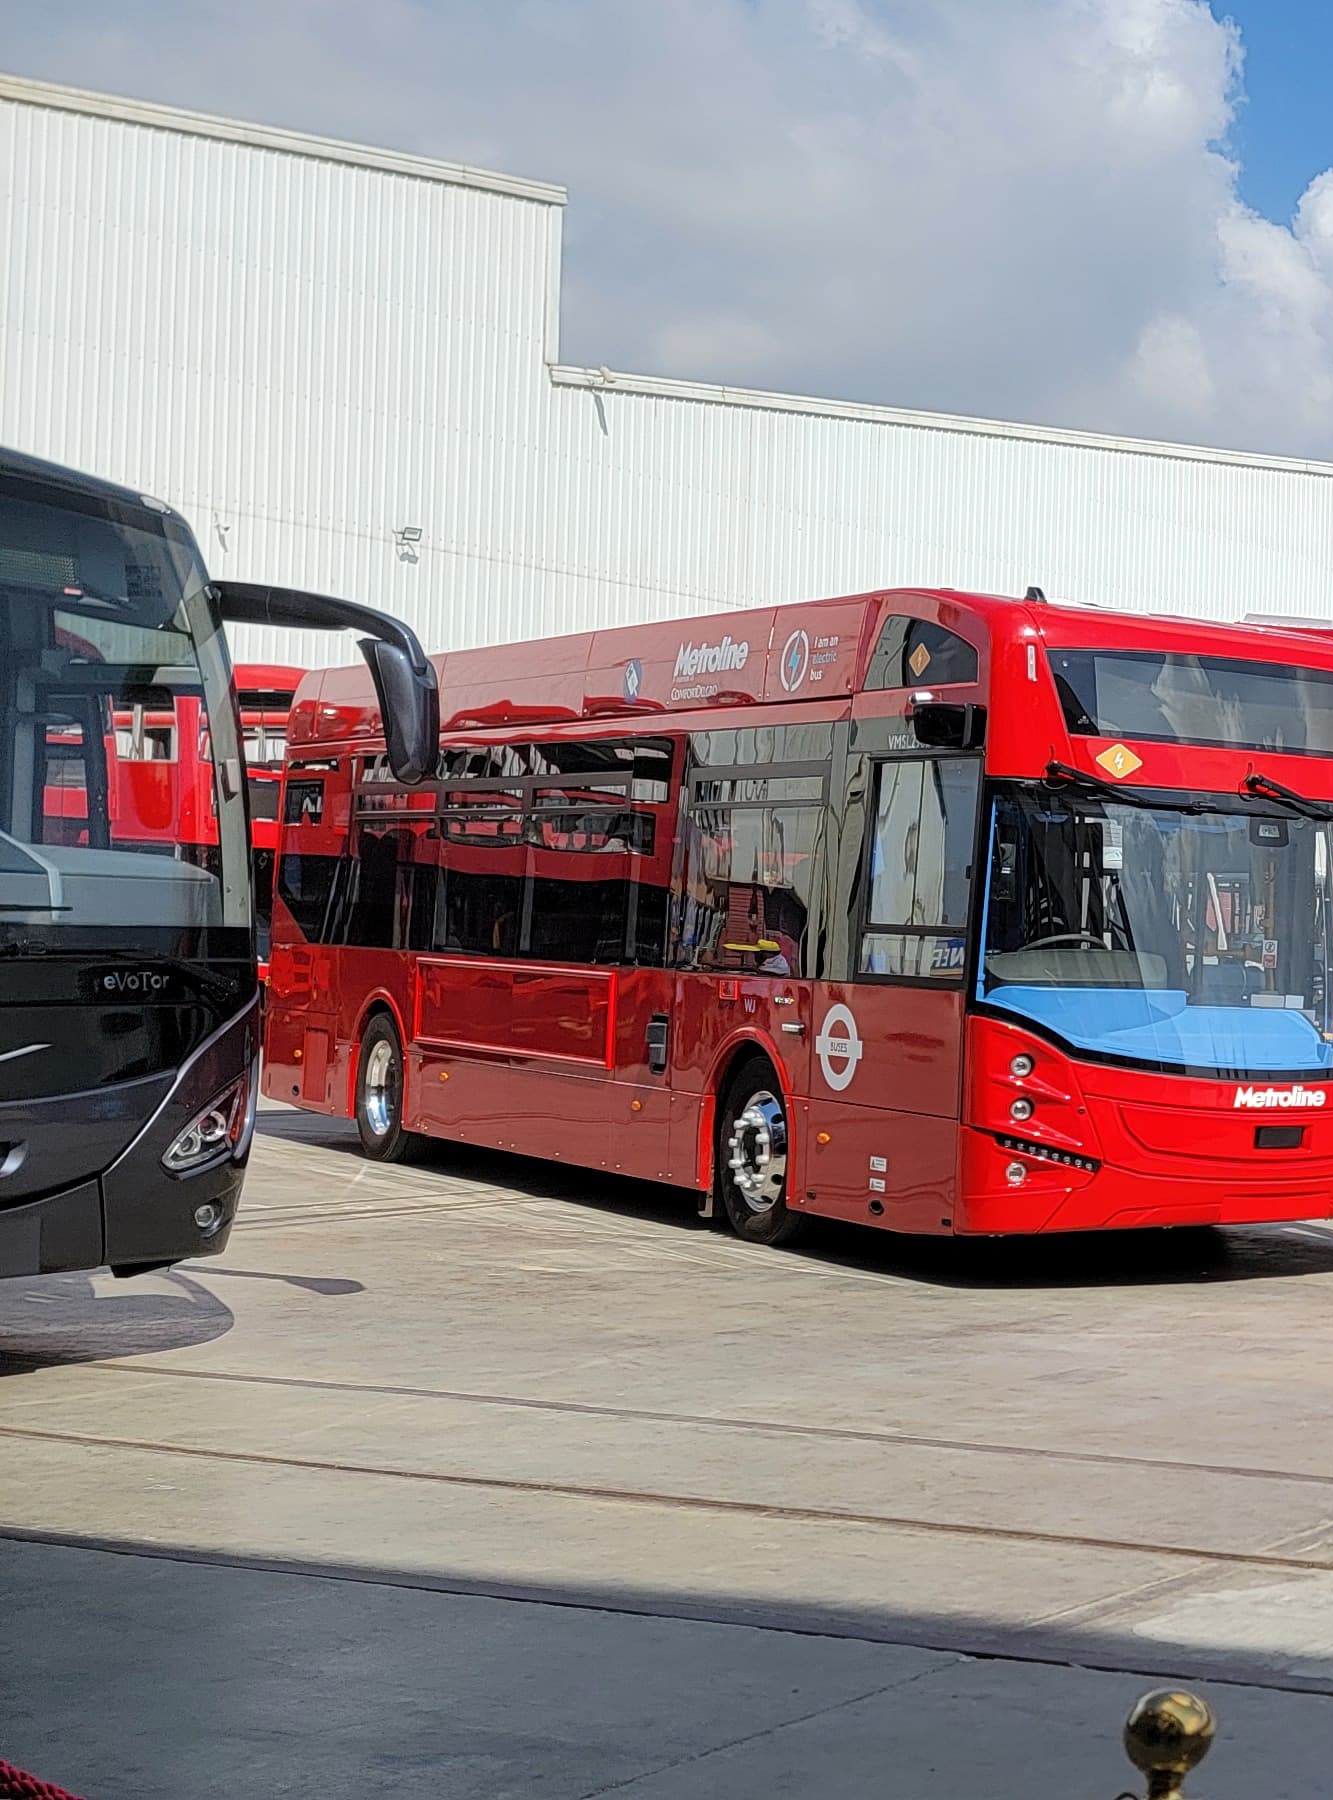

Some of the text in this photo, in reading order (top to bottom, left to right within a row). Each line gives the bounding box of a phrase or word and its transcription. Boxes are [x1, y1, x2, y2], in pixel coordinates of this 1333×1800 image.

[674, 636, 748, 677] Metroline
[810, 668, 823, 681] bus
[103, 971, 170, 991] eVoTor
[1233, 1085, 1327, 1109] Metroline
